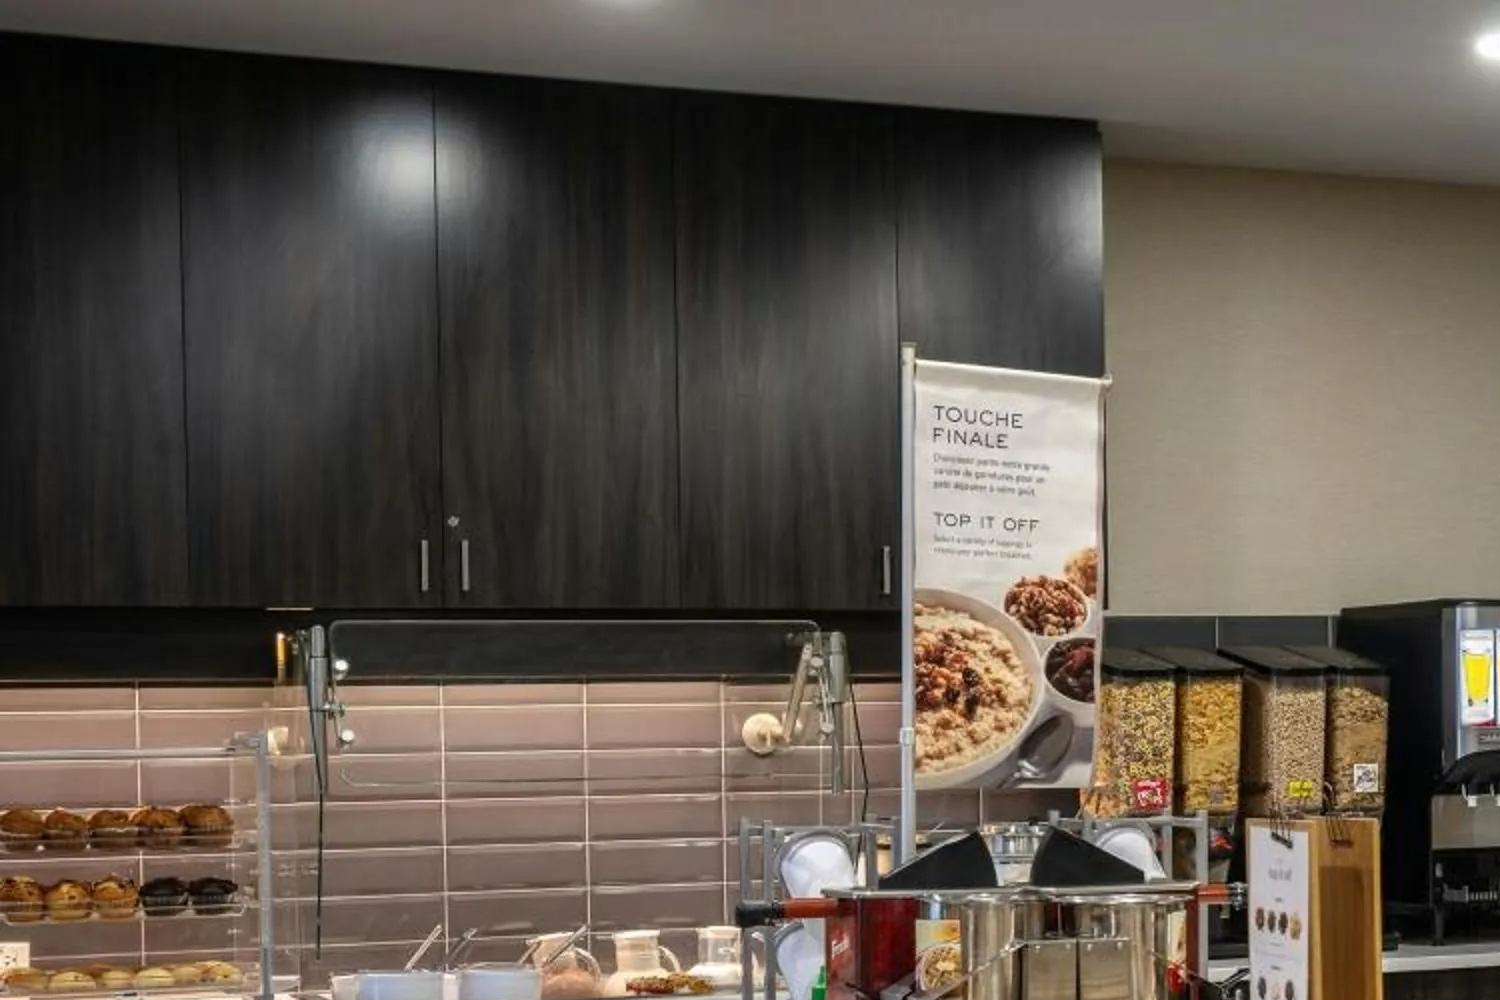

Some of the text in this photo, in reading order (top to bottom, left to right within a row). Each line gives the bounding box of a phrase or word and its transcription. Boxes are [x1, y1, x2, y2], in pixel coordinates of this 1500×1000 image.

[933, 405, 1024, 429] TOUCHE
[932, 427, 1009, 449] FINALE
[933, 512, 1040, 533] TOP IT OFF
